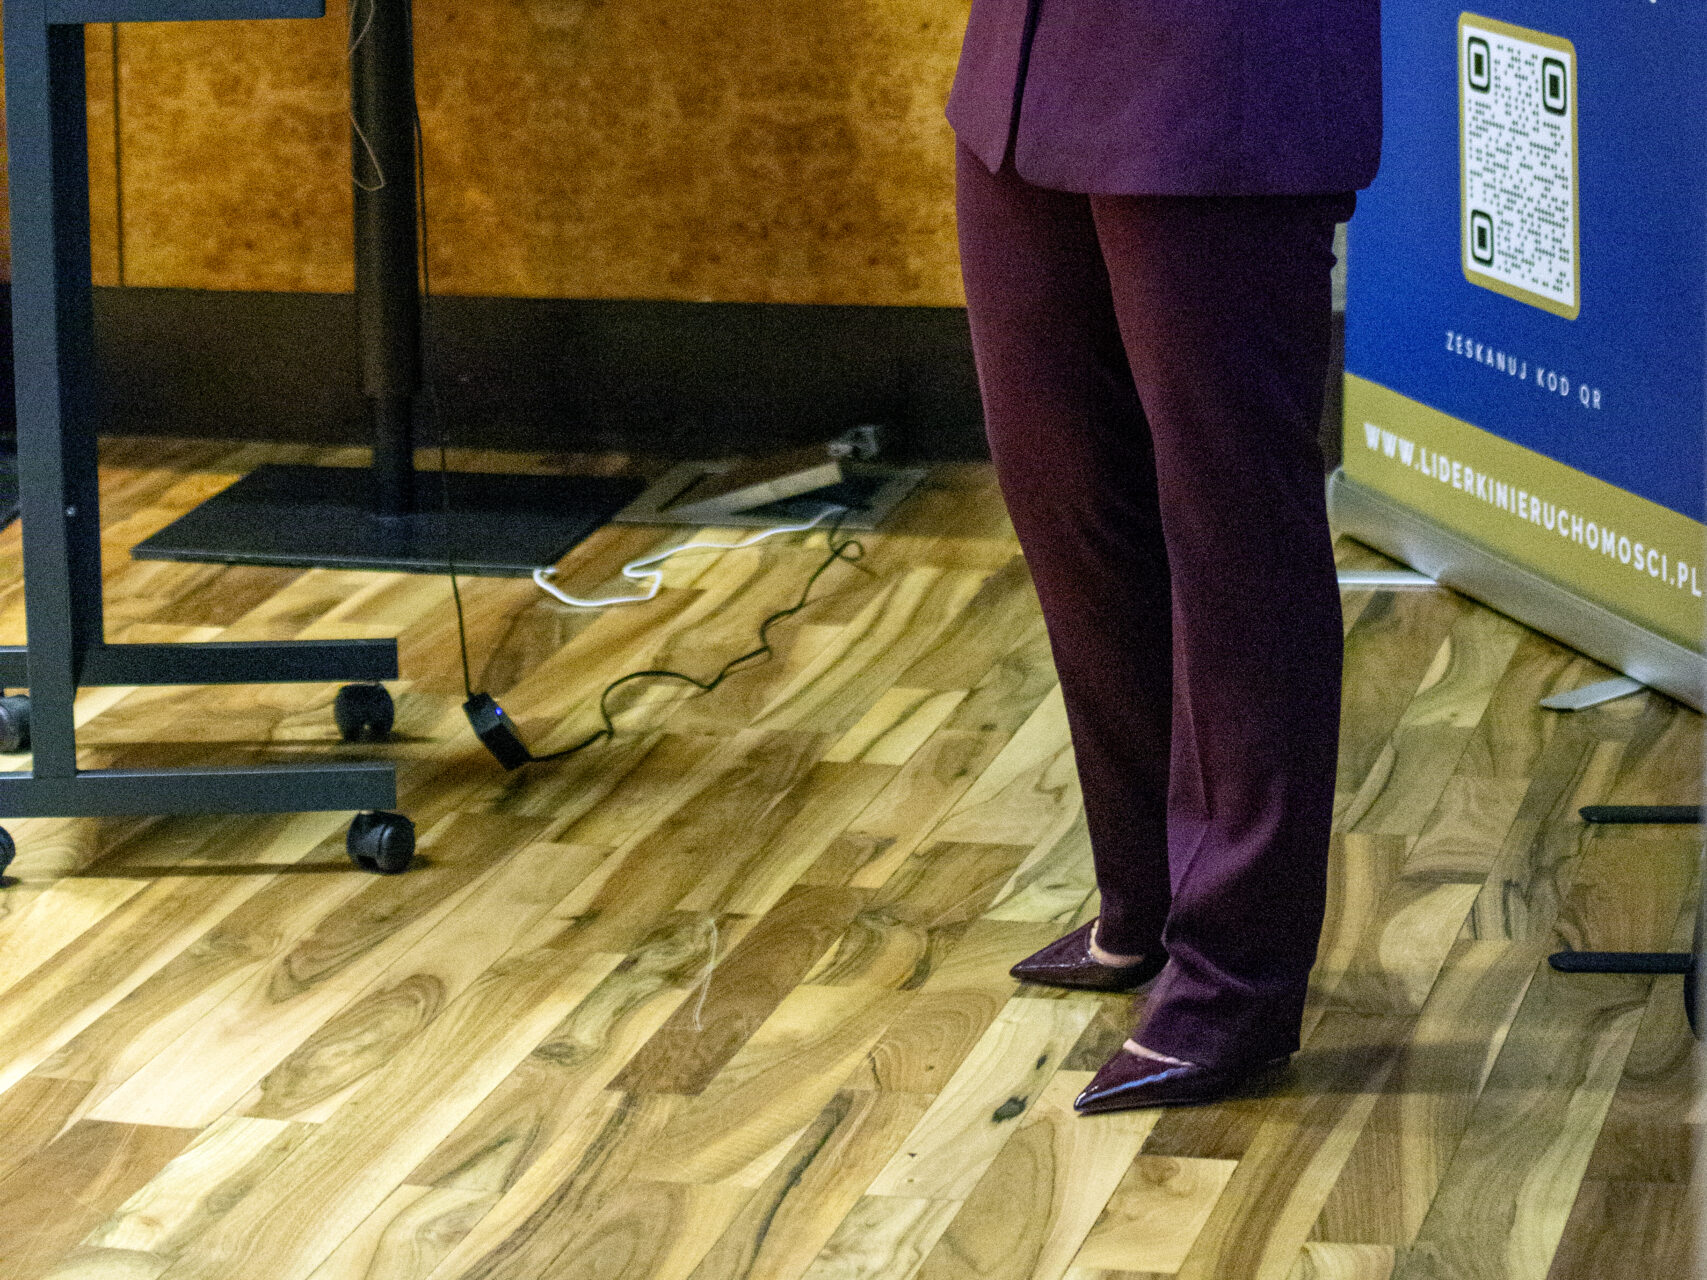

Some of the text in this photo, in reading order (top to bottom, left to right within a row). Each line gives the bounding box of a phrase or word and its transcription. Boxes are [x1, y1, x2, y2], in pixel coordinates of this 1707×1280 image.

[1446, 331, 1601, 410] ZESKANUJ KOD QR
[1363, 421, 1703, 598] WWW.LIDERKINIERUCHOMOSCI.PL
